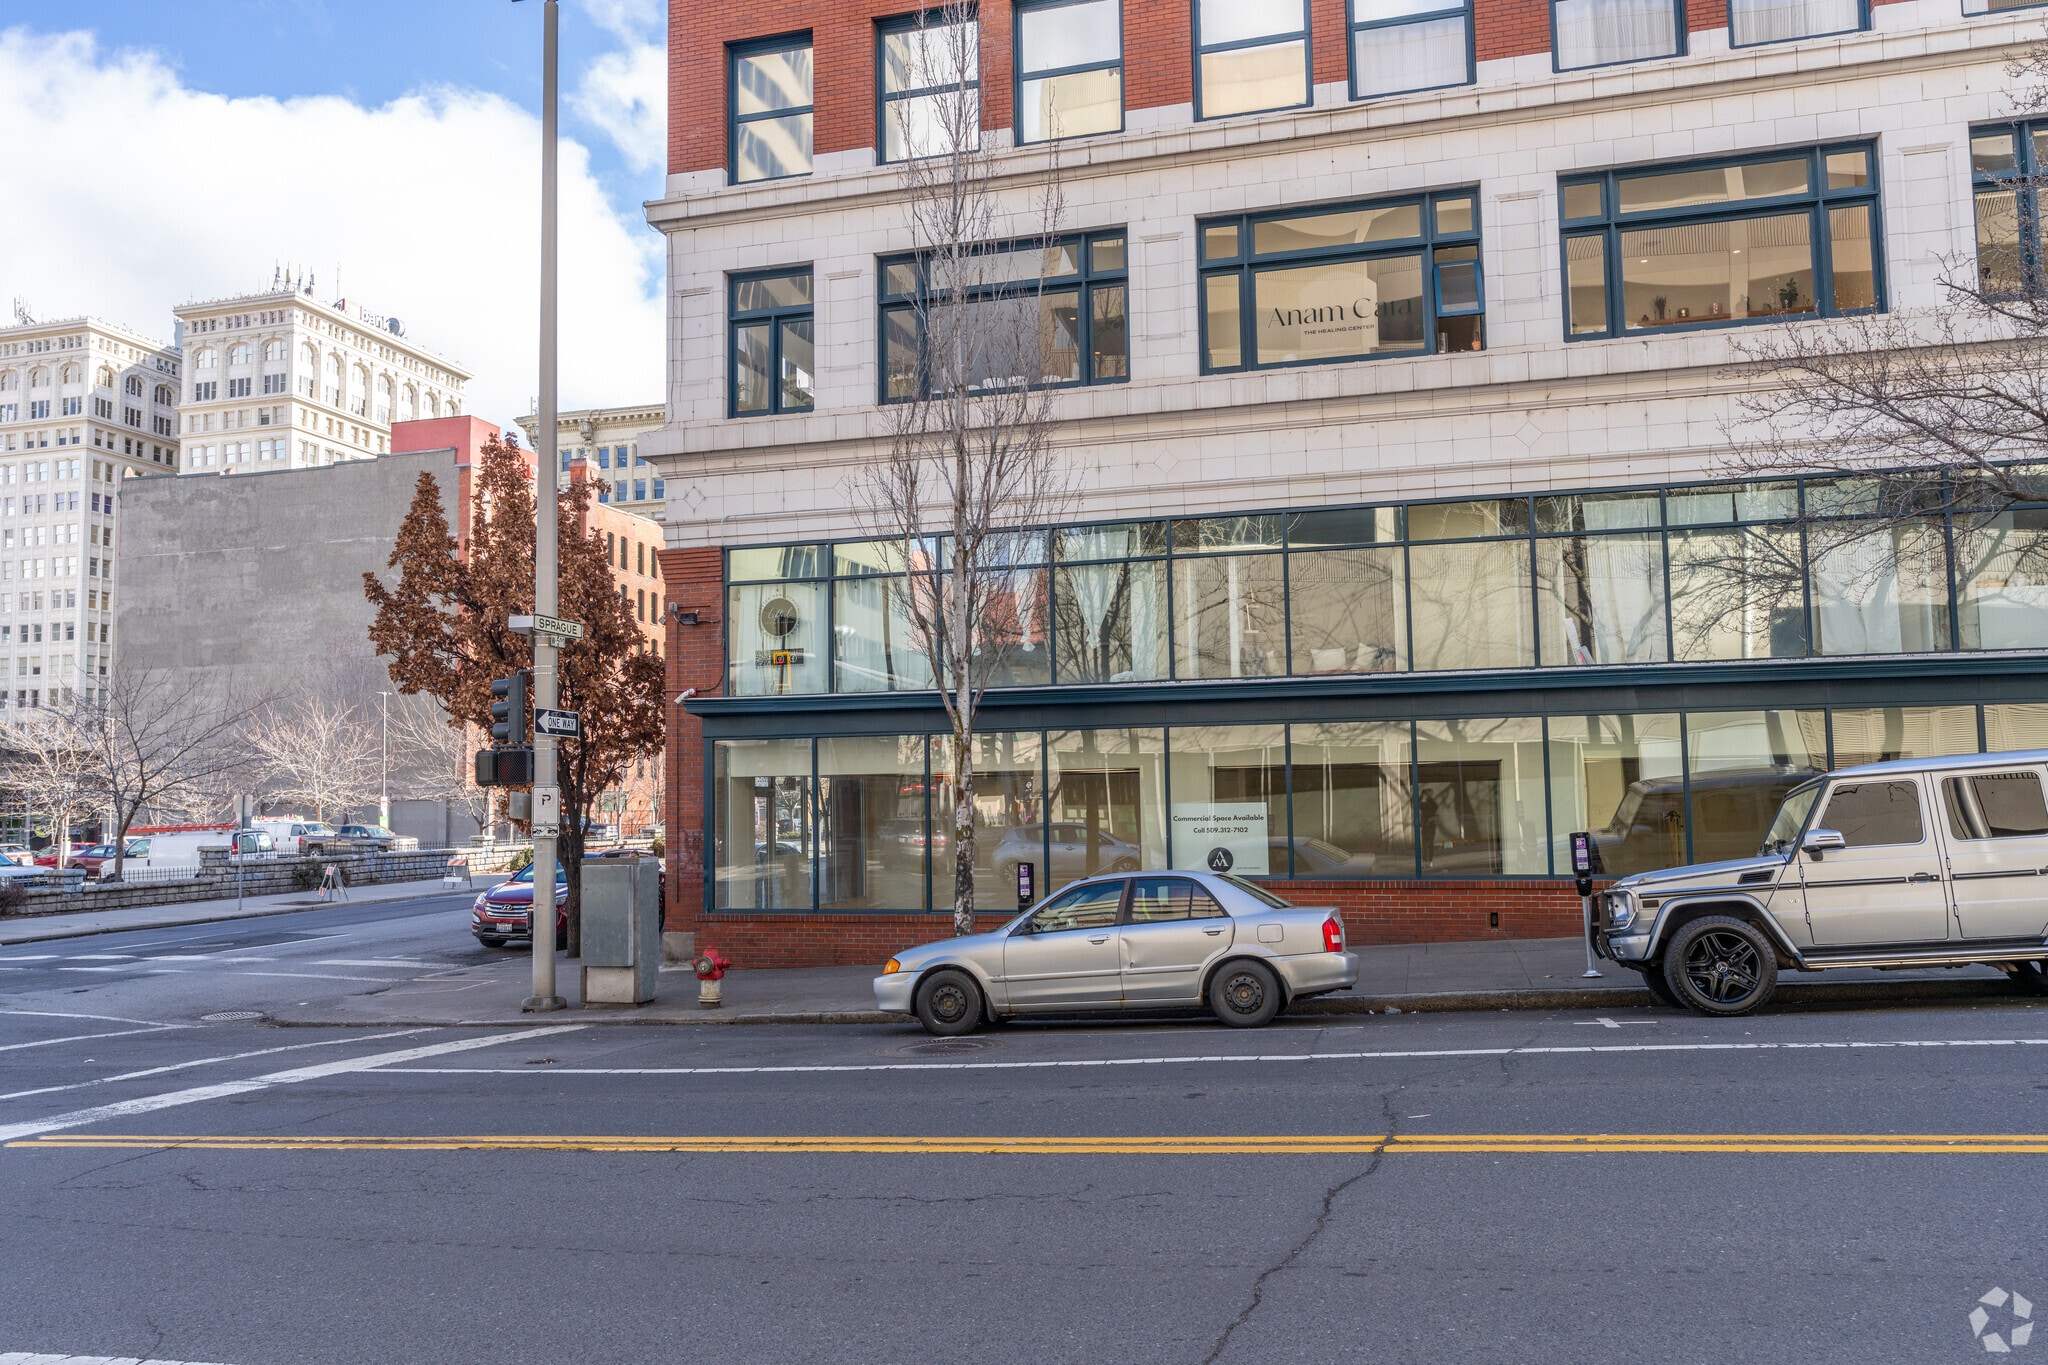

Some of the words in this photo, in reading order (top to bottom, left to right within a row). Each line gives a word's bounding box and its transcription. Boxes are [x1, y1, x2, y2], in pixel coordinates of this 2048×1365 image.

[1268, 304, 1344, 328] Anam
[1318, 326, 1347, 334] HEALING
[538, 618, 577, 635] SPRAGUE
[548, 717, 560, 728] ONE
[562, 719, 575, 729] WAY
[1212, 814, 1232, 823] Space
